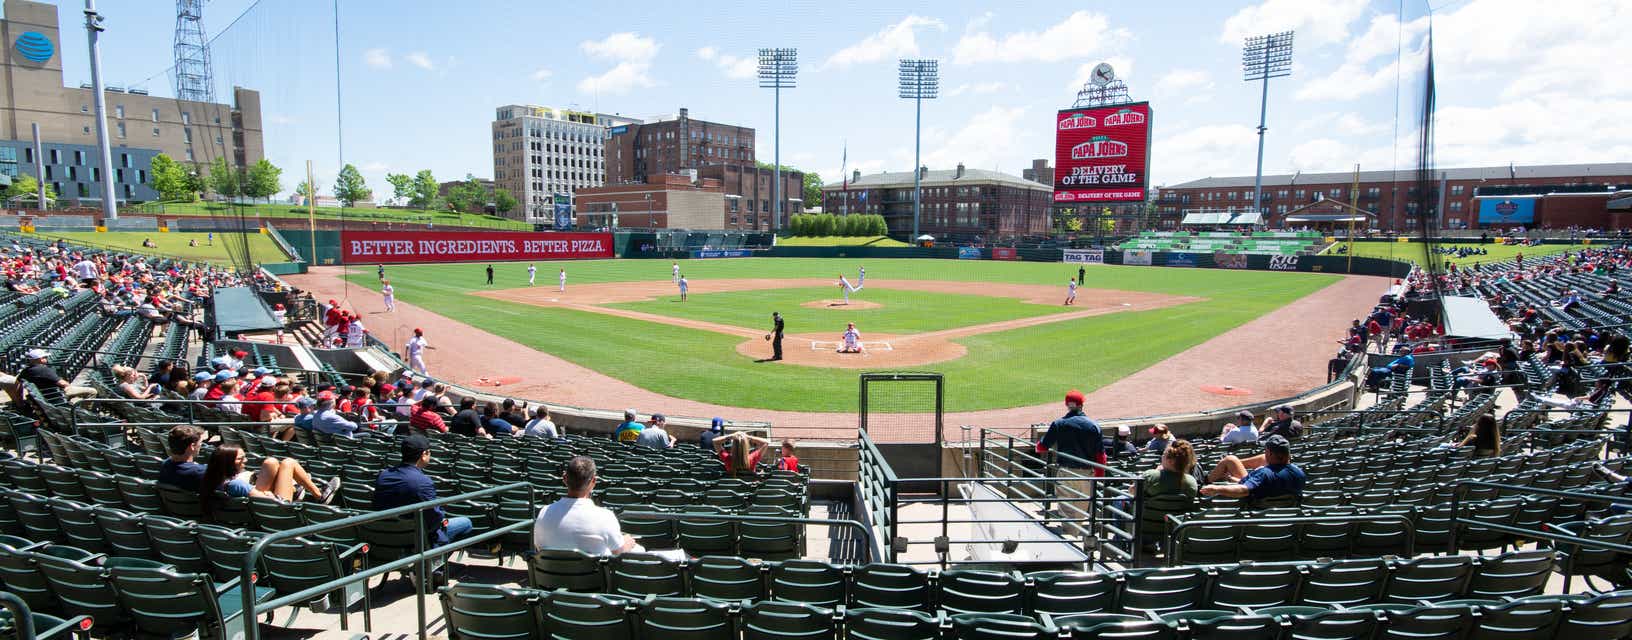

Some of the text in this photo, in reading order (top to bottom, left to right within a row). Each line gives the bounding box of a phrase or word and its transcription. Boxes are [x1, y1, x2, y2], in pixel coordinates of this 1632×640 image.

[1060, 119, 1075, 129] PAPA
[1105, 115, 1121, 126] PAPA
[1073, 142, 1126, 157] PAPA JOHNS
[1072, 164, 1126, 176] DELIVERY
[1062, 173, 1136, 185] OF THE GAME
[351, 239, 606, 256] BETTER INGREDIENTS. BETTER PIZZA.
[1064, 253, 1102, 262] TAG TAG
